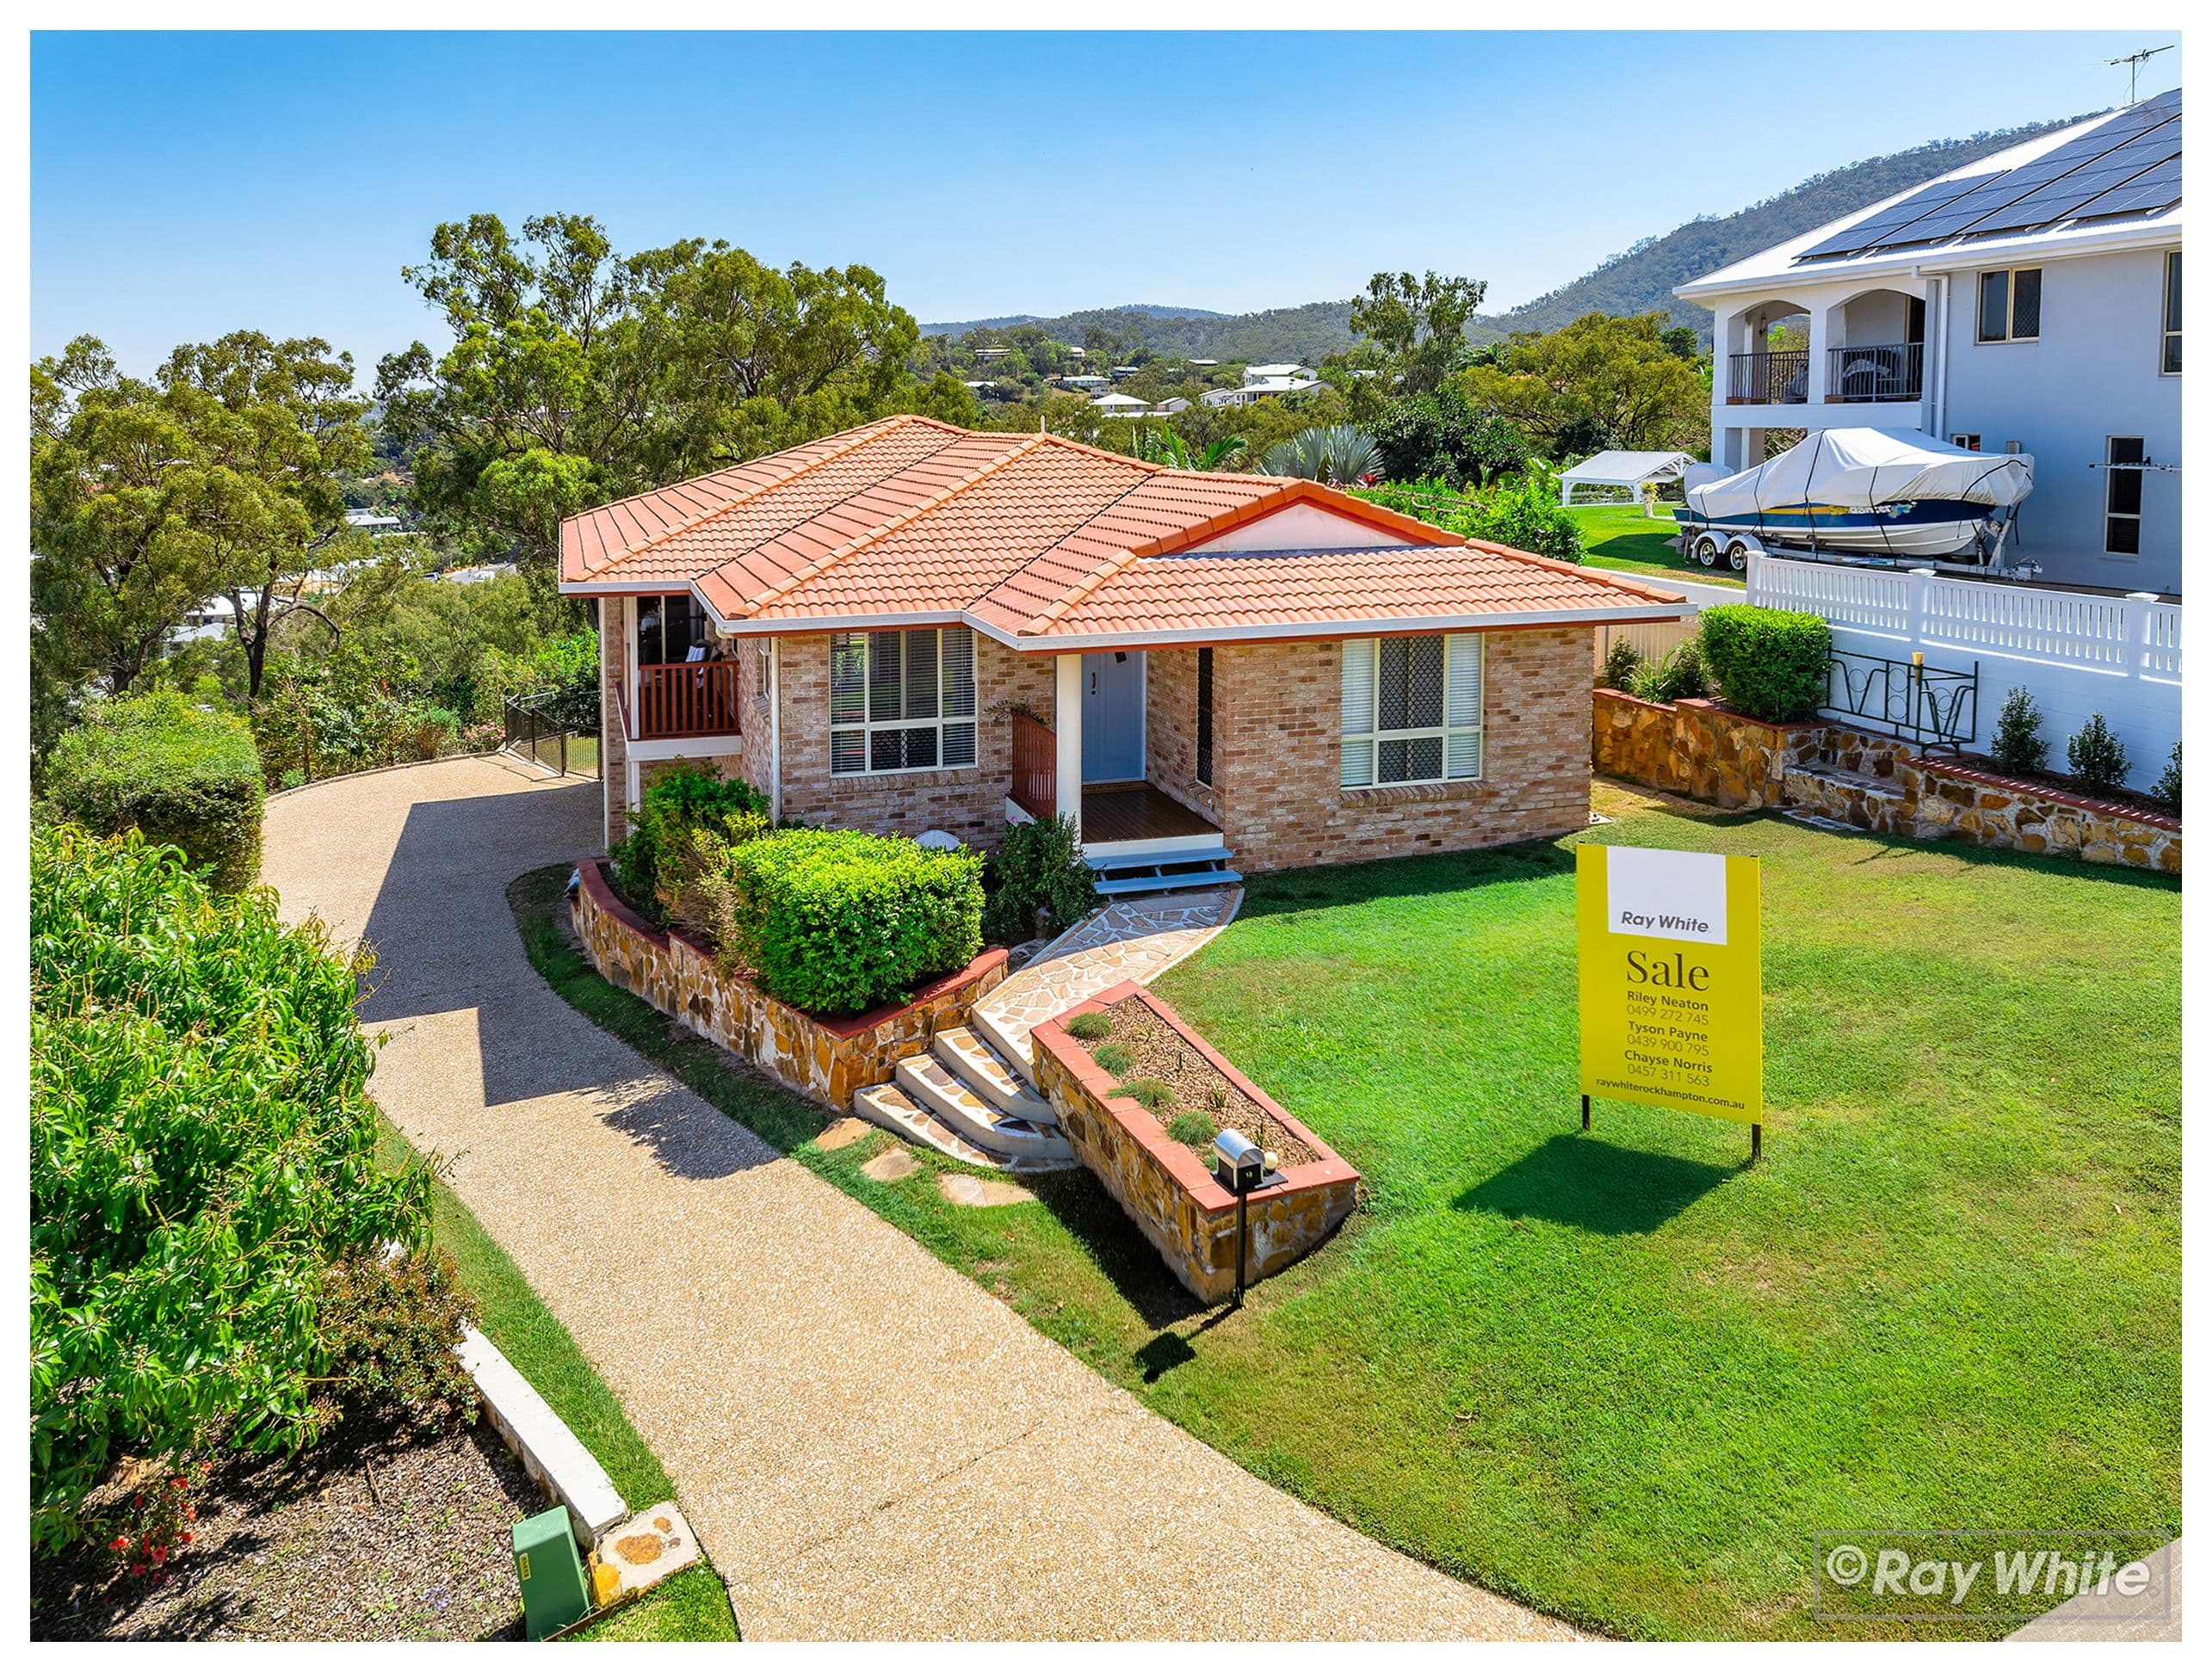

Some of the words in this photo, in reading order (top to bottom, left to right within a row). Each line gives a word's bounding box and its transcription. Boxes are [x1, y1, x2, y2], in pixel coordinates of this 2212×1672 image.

[1621, 910, 1656, 929] Ray
[1659, 915, 1709, 933] White
[1626, 950, 1710, 991] Sale
[1627, 990, 1657, 1006] Riley
[1661, 995, 1708, 1011] Neaton
[1627, 1003, 1657, 1018] 0499
[1659, 1008, 1684, 1022] 272
[1686, 1012, 1709, 1026] 745
[1628, 1021, 1665, 1034] Tyson
[1670, 1026, 1708, 1042] Payne
[1627, 1033, 1657, 1047] 0439
[1659, 1038, 1684, 1052] 900
[1686, 1042, 1709, 1057] 795
[1624, 1050, 1670, 1066] Chayse
[1673, 1057, 1713, 1073] Norris
[1627, 1063, 1657, 1077] 0457
[1659, 1068, 1682, 1082] 311
[1686, 1073, 1709, 1087] 563
[1596, 1077, 1746, 1109] raywhiterockhampton.com.au
